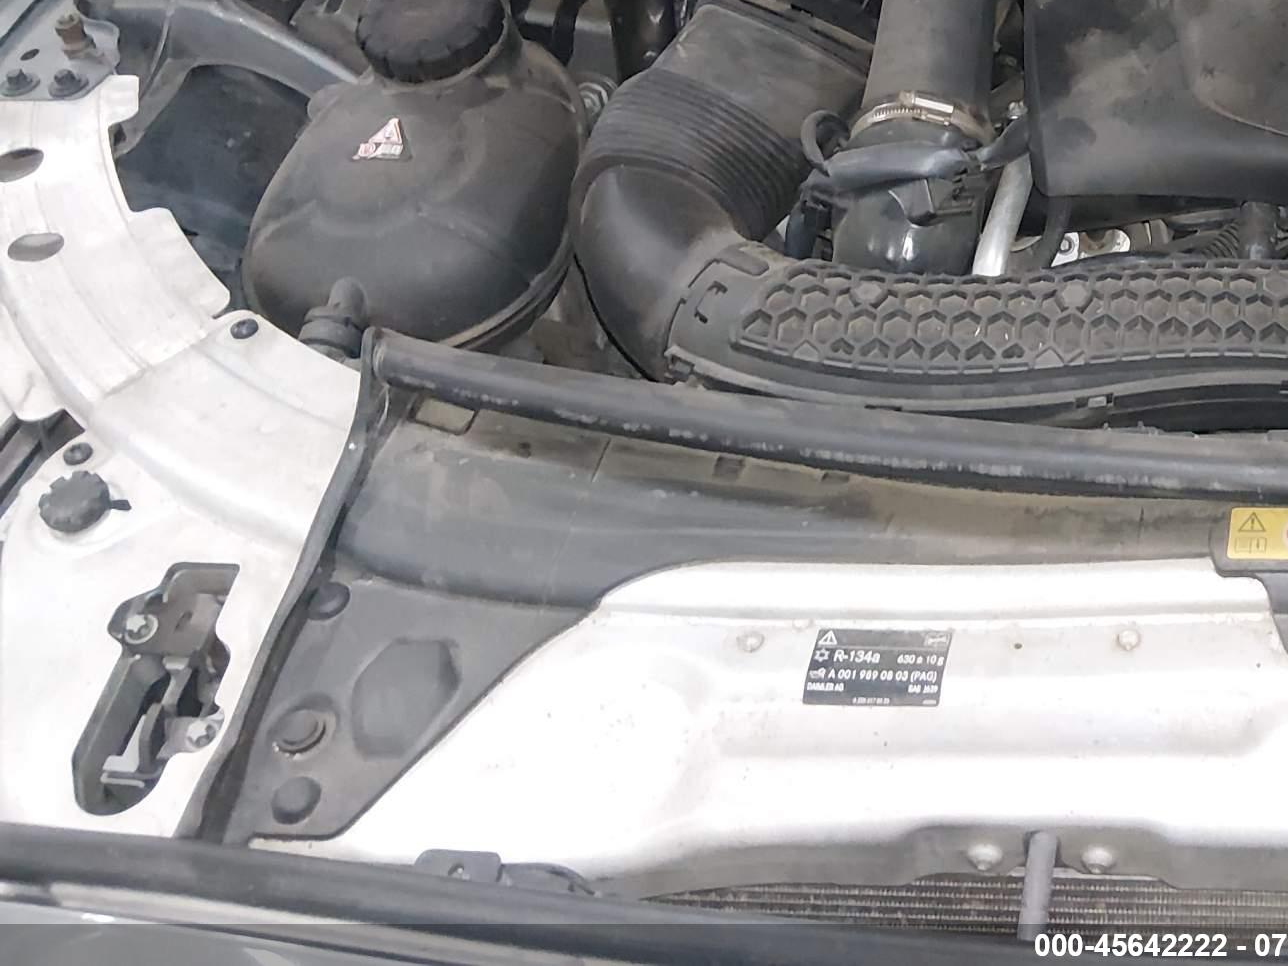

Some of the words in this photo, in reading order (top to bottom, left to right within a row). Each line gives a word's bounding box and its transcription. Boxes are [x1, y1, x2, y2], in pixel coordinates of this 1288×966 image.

[833, 649, 881, 664] R-134a
[896, 654, 916, 665] 630
[926, 654, 937, 665] 10
[828, 668, 836, 680] A
[837, 669, 857, 681] 001
[910, 670, 938, 684] (PAG)
